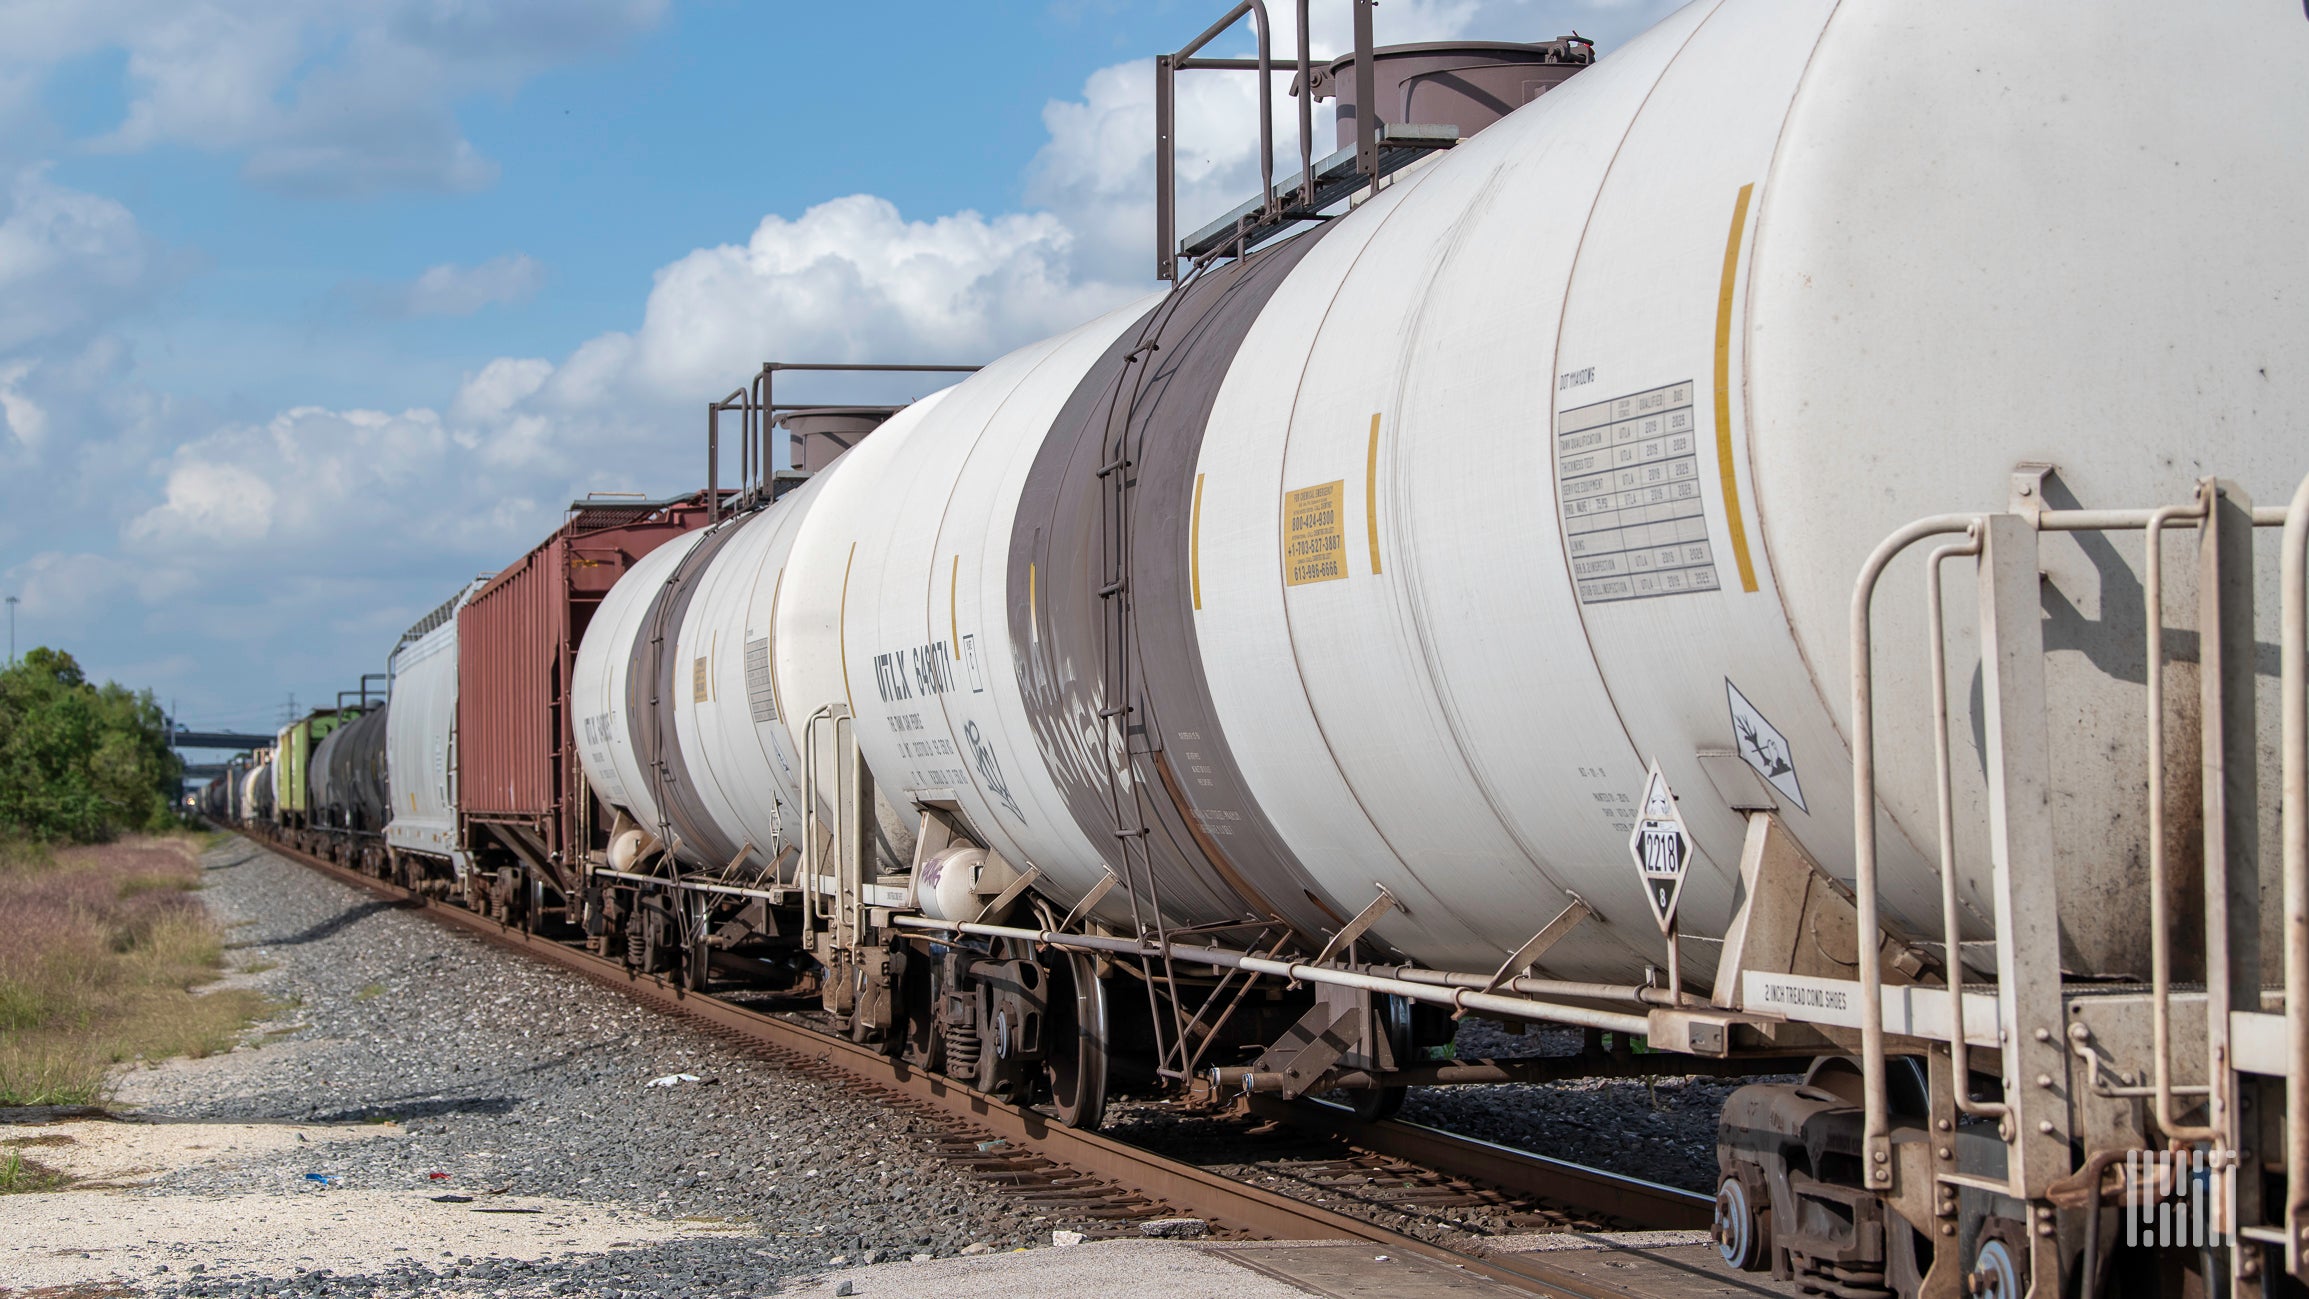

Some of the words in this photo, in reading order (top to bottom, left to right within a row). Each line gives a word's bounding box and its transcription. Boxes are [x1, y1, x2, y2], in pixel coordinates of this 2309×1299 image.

[1560, 373, 1569, 390] DOT
[1639, 394, 1663, 410] QUALIFIED
[1292, 509, 1334, 532] 800-424-9300
[1288, 535, 1340, 557] +1-703-527-3887
[1294, 561, 1338, 581] 613-996-6666
[874, 650, 912, 703] UTLX
[913, 640, 956, 697] 648071
[1646, 834, 1676, 872] 2218
[1659, 887, 1667, 908] 8
[1765, 984, 1769, 1001] 2
[1770, 984, 1785, 1003] INCH
[1786, 986, 1805, 1005] TREAD
[1825, 991, 1847, 1010] SHOES
